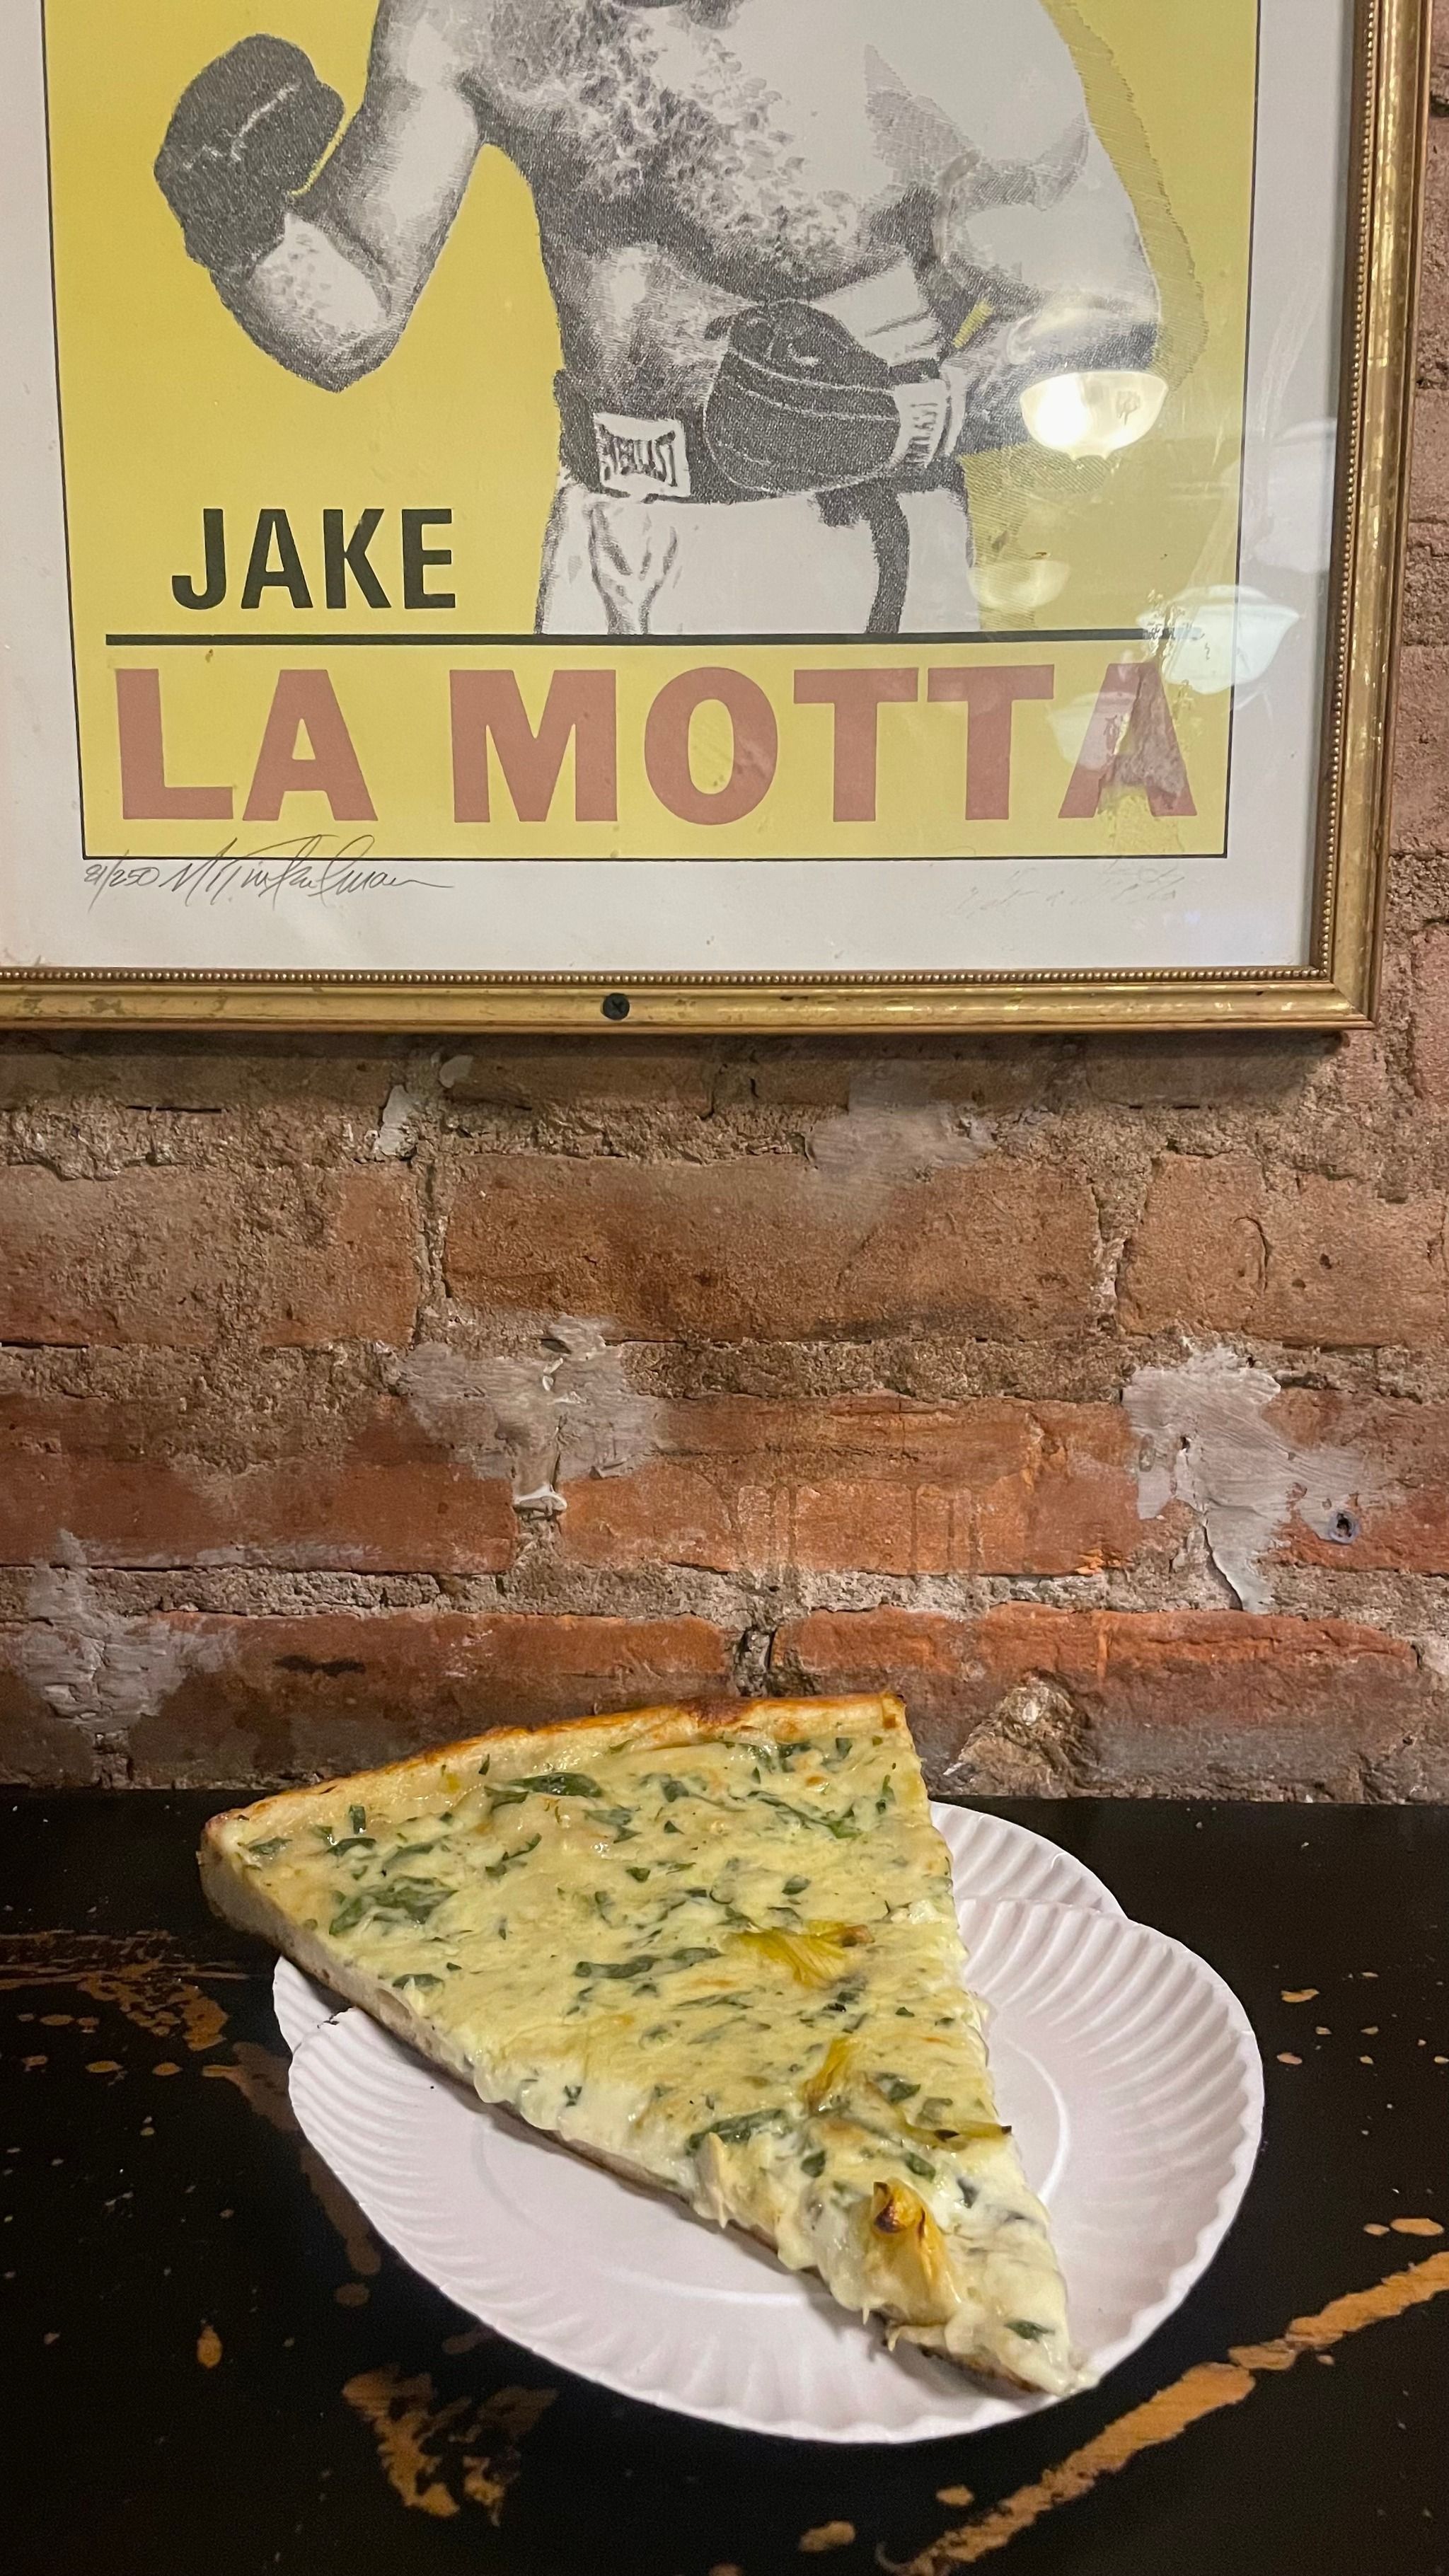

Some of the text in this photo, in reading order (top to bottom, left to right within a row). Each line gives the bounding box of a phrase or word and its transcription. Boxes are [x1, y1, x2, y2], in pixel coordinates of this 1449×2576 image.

[171, 508, 456, 610] JAKE
[115, 662, 1198, 826] LA MOTTA
